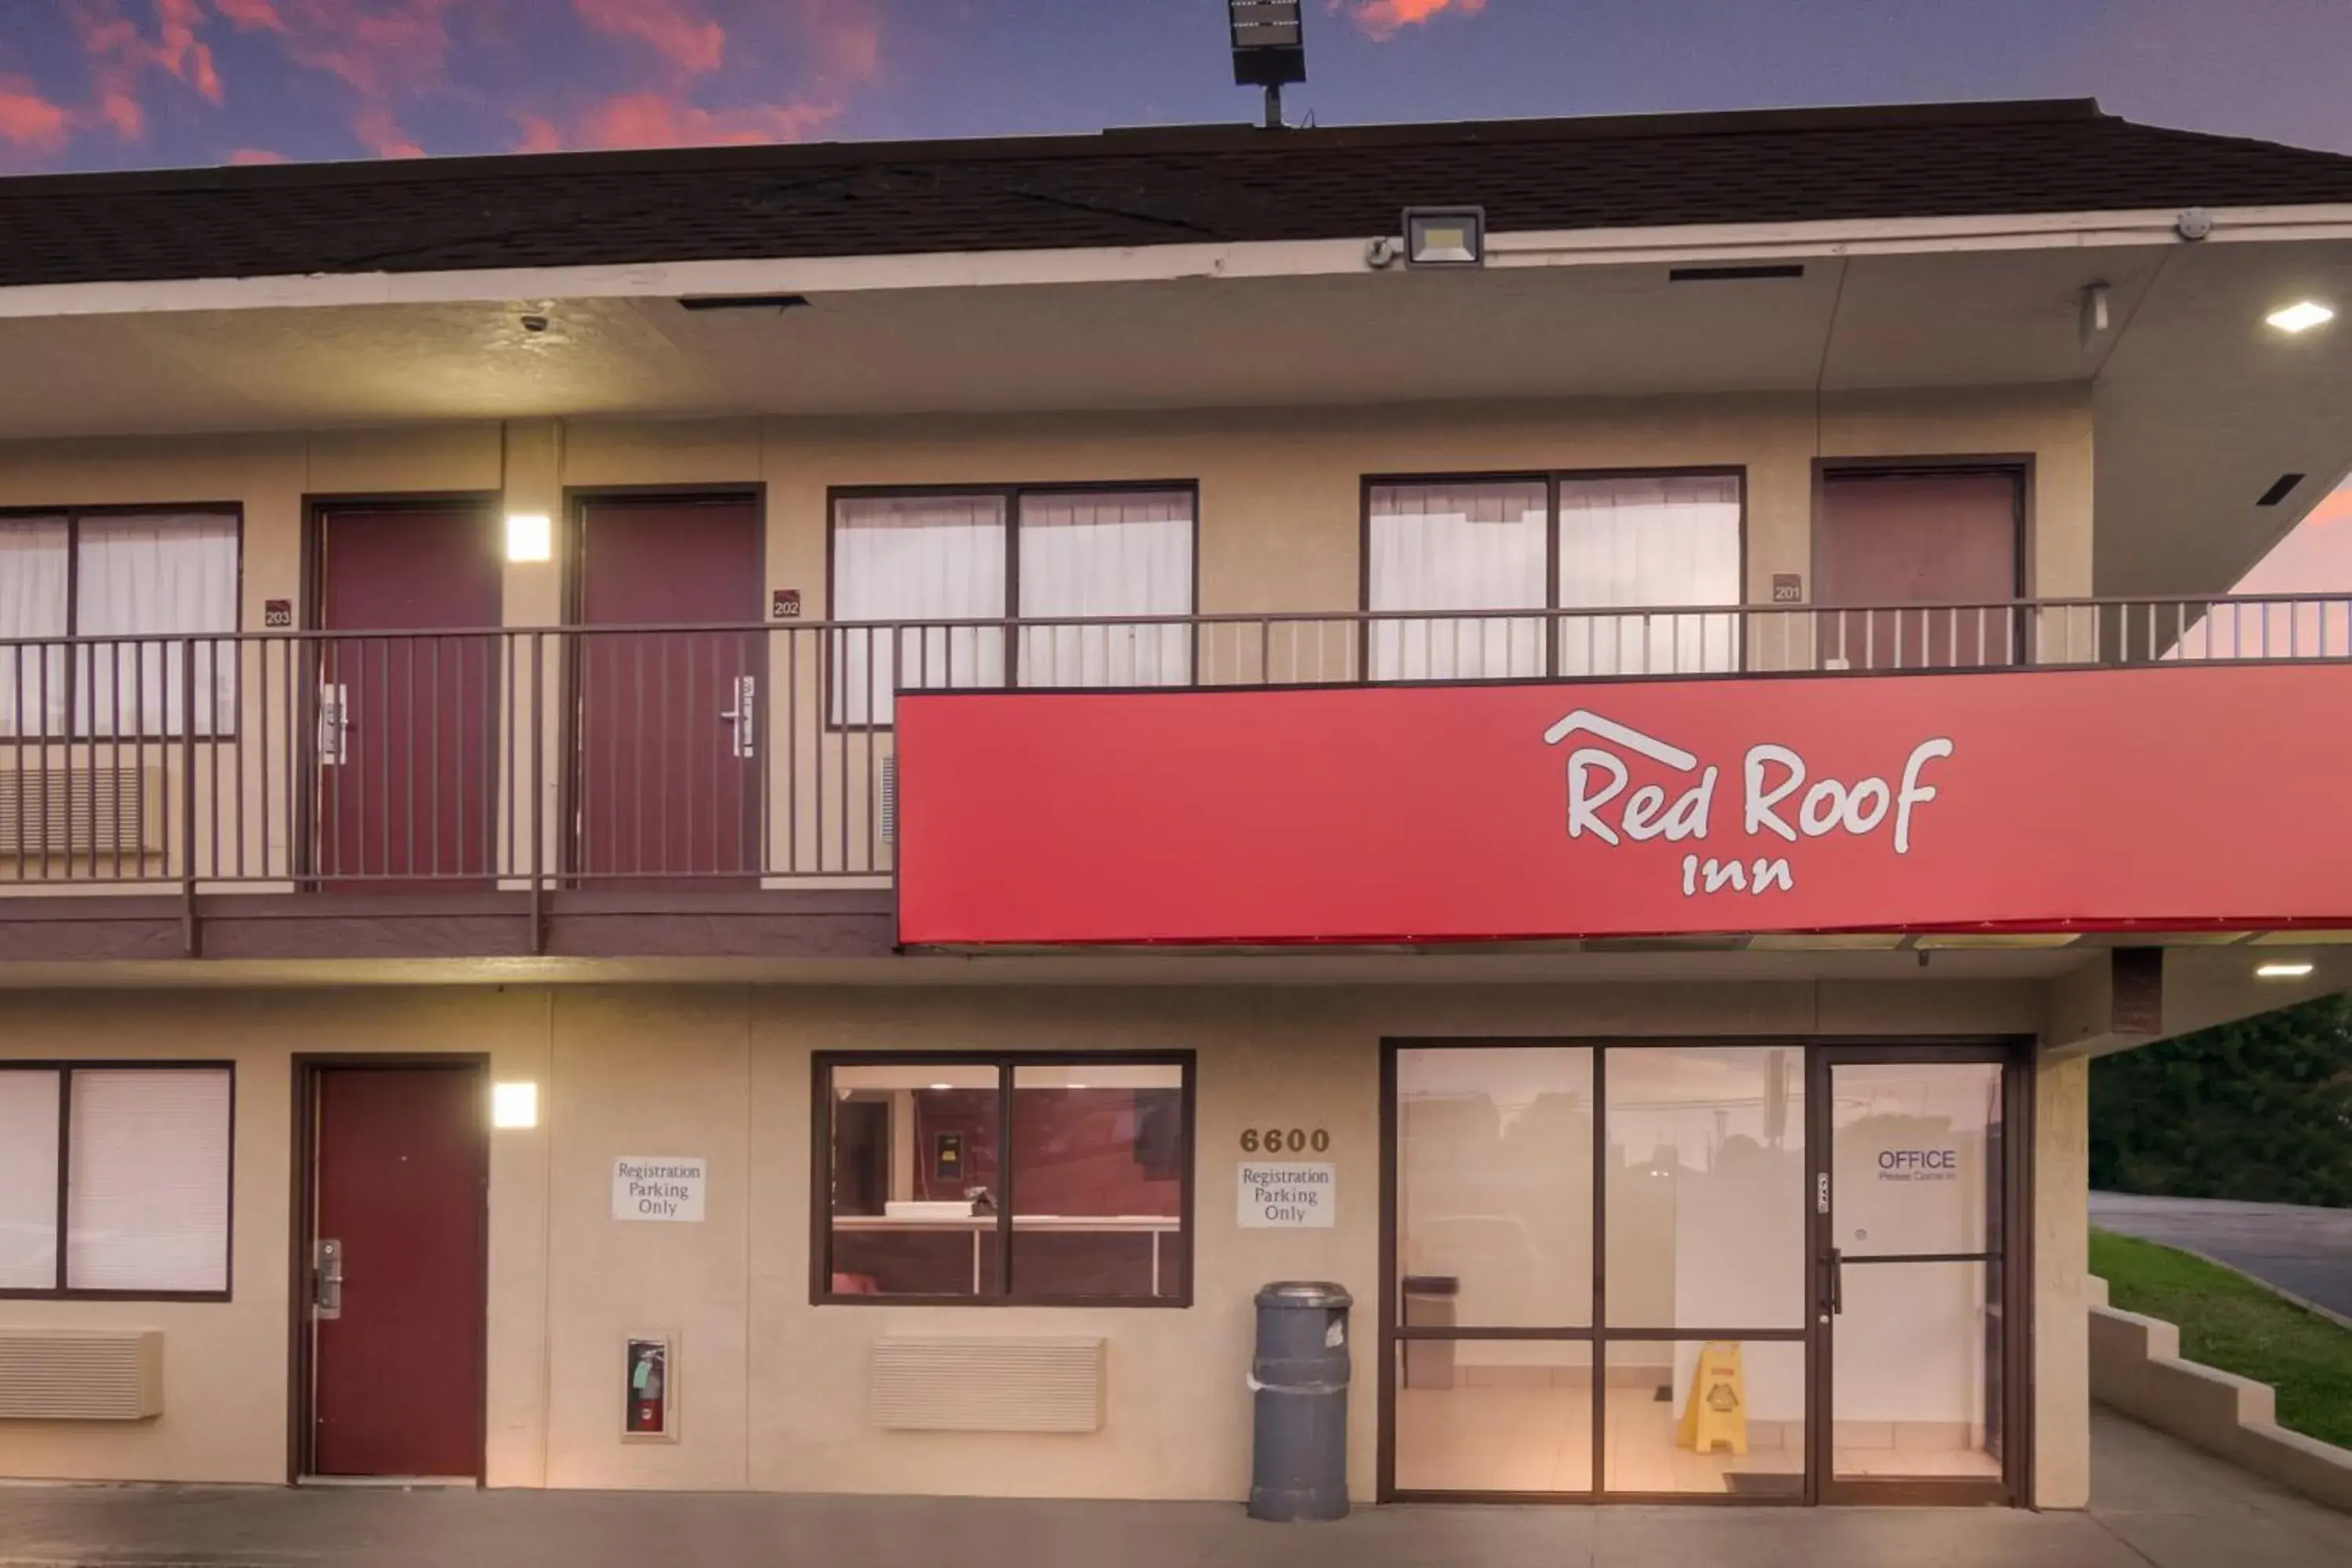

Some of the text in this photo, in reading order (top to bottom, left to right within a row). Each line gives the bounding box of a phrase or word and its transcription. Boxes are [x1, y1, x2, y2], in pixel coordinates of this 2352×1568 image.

[1775, 586, 1800, 600] 201
[775, 602, 799, 615] 202
[266, 612, 290, 625] 203
[1567, 737, 1955, 855] Red Roof
[1240, 1128, 1330, 1153] 6600
[1878, 1150, 1957, 1169] OFFICE
[619, 1162, 701, 1180] Registration
[1243, 1167, 1330, 1187] Registration
[630, 1181, 690, 1201] Parking
[1254, 1187, 1318, 1207] Parking
[639, 1199, 677, 1217] Only
[1265, 1205, 1305, 1223] Only
